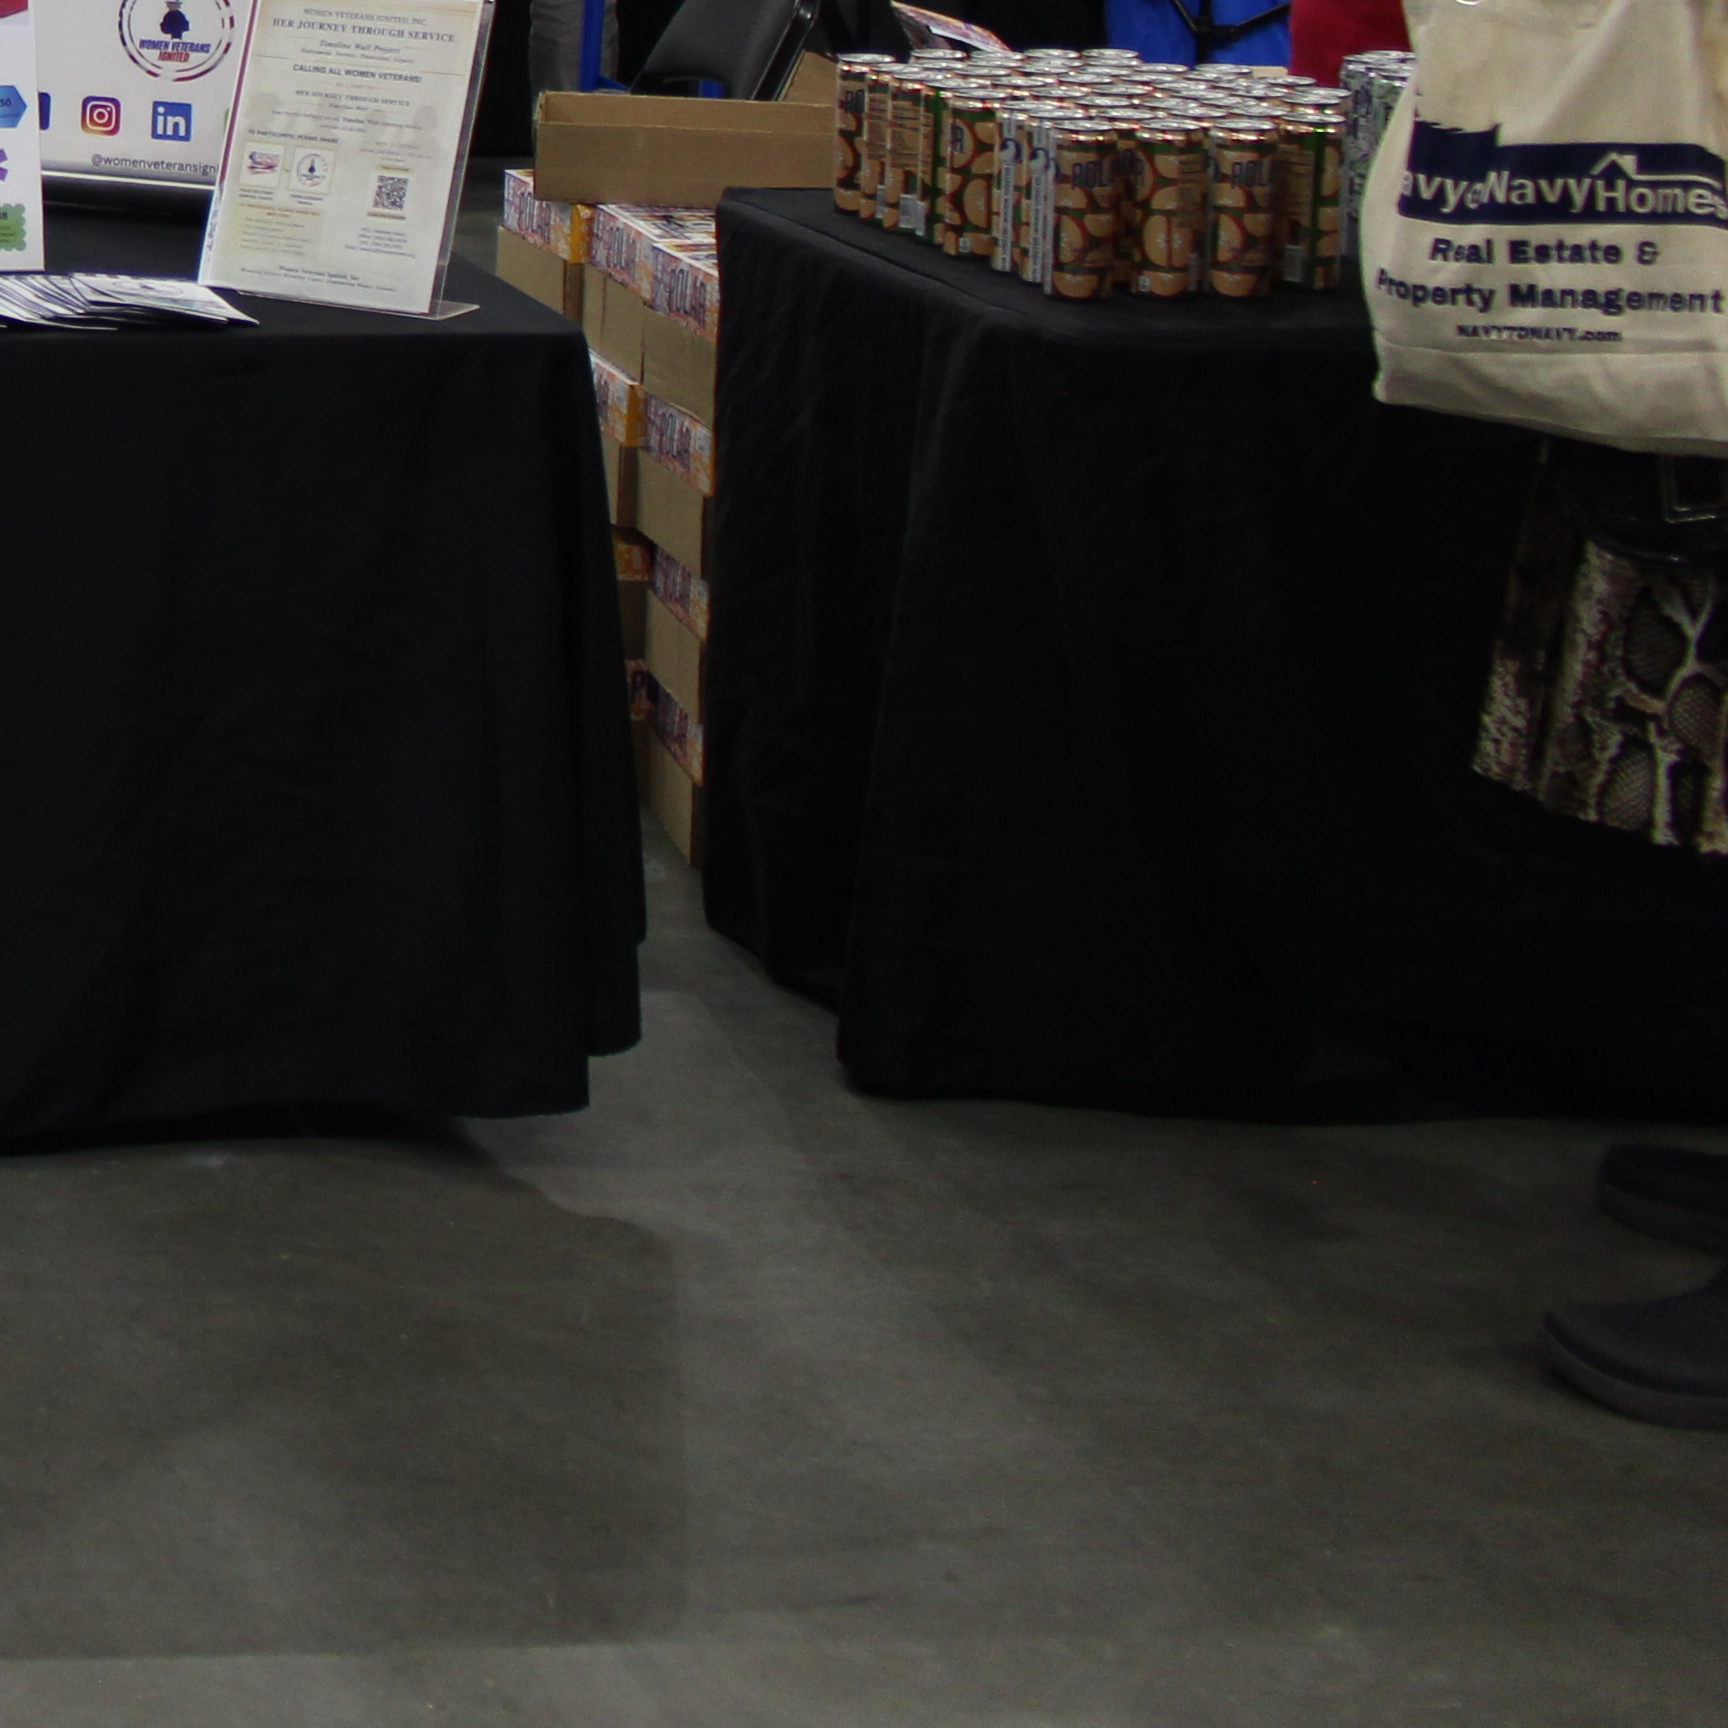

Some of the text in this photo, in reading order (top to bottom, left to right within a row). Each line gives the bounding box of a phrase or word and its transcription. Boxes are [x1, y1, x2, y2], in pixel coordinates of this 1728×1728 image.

[272, 18, 455, 43] HER JOURNEY THROUGH SERVICE
[139, 38, 212, 53] WOMEN VETERANS
[157, 50, 190, 63] IGNITED
[344, 68, 376, 79] WOMEN
[156, 106, 186, 137] in
[1430, 237, 1659, 265] Real Estate &
[1508, 282, 1725, 317] Management
